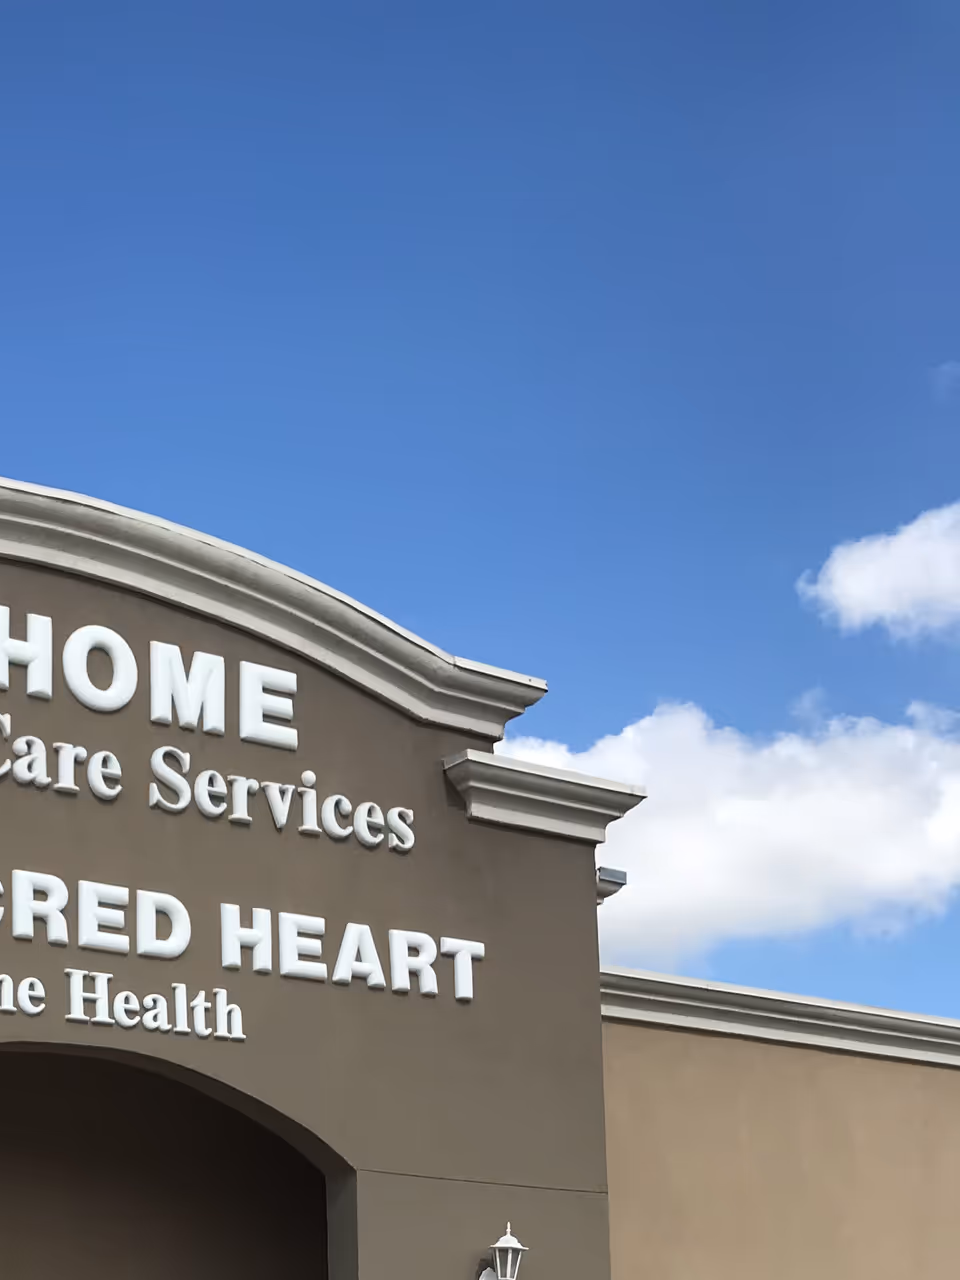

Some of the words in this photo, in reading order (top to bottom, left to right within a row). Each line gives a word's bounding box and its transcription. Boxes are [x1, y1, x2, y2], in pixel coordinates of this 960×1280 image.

[149, 746, 416, 853] Services
[219, 902, 486, 1002] HEART
[65, 968, 247, 1042] Health
